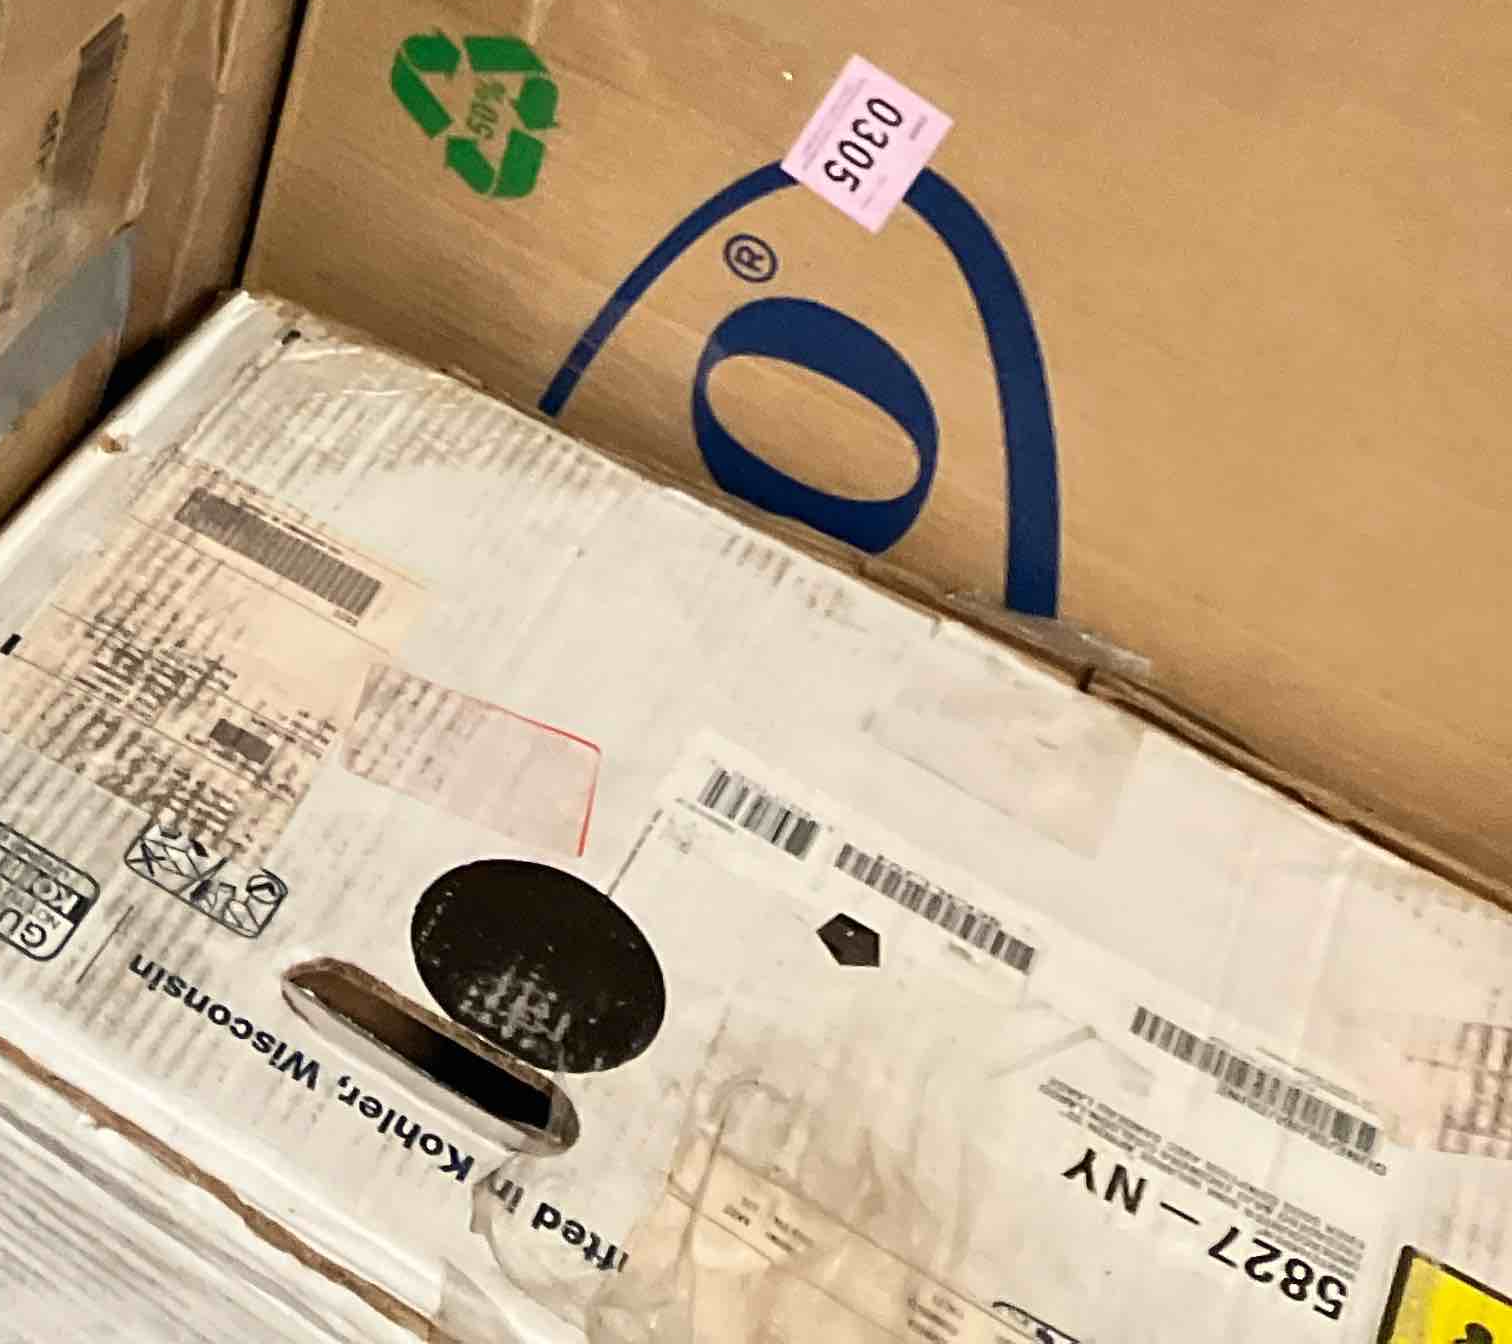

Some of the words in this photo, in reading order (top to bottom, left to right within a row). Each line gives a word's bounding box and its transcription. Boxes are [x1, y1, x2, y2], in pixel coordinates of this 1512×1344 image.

[825, 96, 903, 194] 0305
[128, 953, 321, 1091] Wisconsin
[336, 1072, 476, 1183] Kohler,
[489, 1174, 524, 1215] in
[1061, 1147, 1149, 1216] NY
[531, 1200, 628, 1274] fted
[1208, 1225, 1348, 1320] 5827
